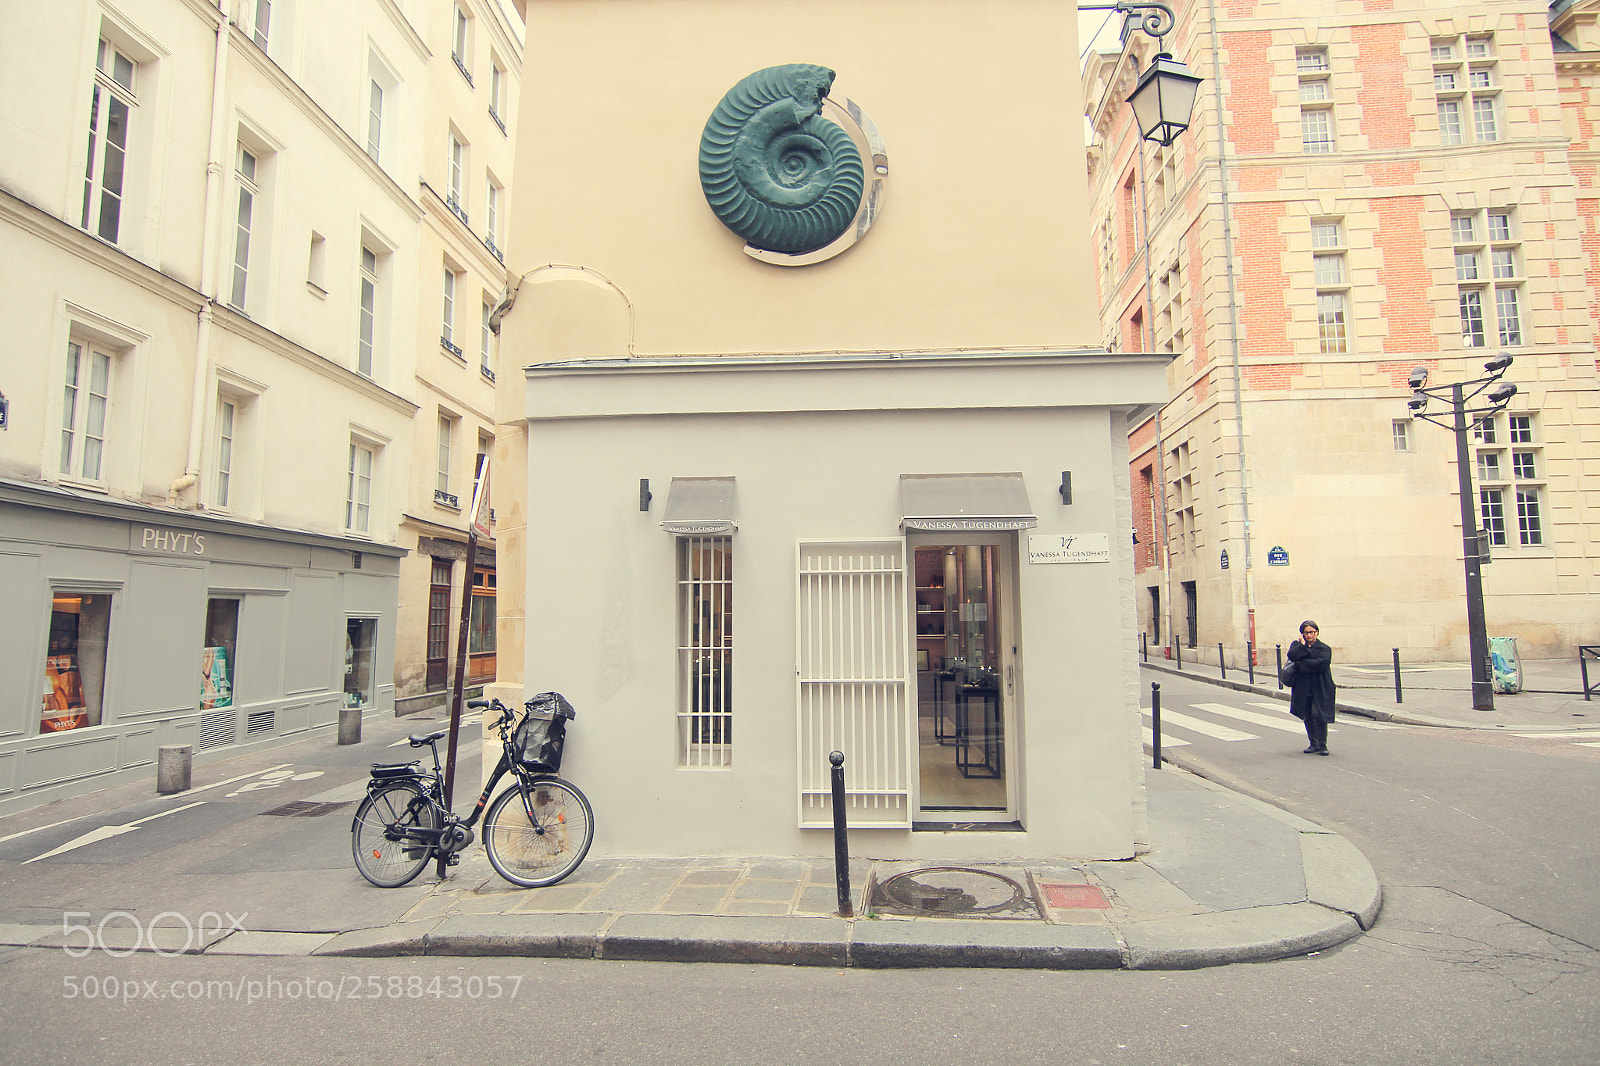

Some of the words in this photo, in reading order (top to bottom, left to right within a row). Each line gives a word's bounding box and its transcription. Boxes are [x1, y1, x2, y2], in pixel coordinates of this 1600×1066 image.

[913, 520, 958, 529] VANESSA
[962, 520, 1030, 529] TUGENDHAFT
[142, 528, 205, 555] PHYT'S
